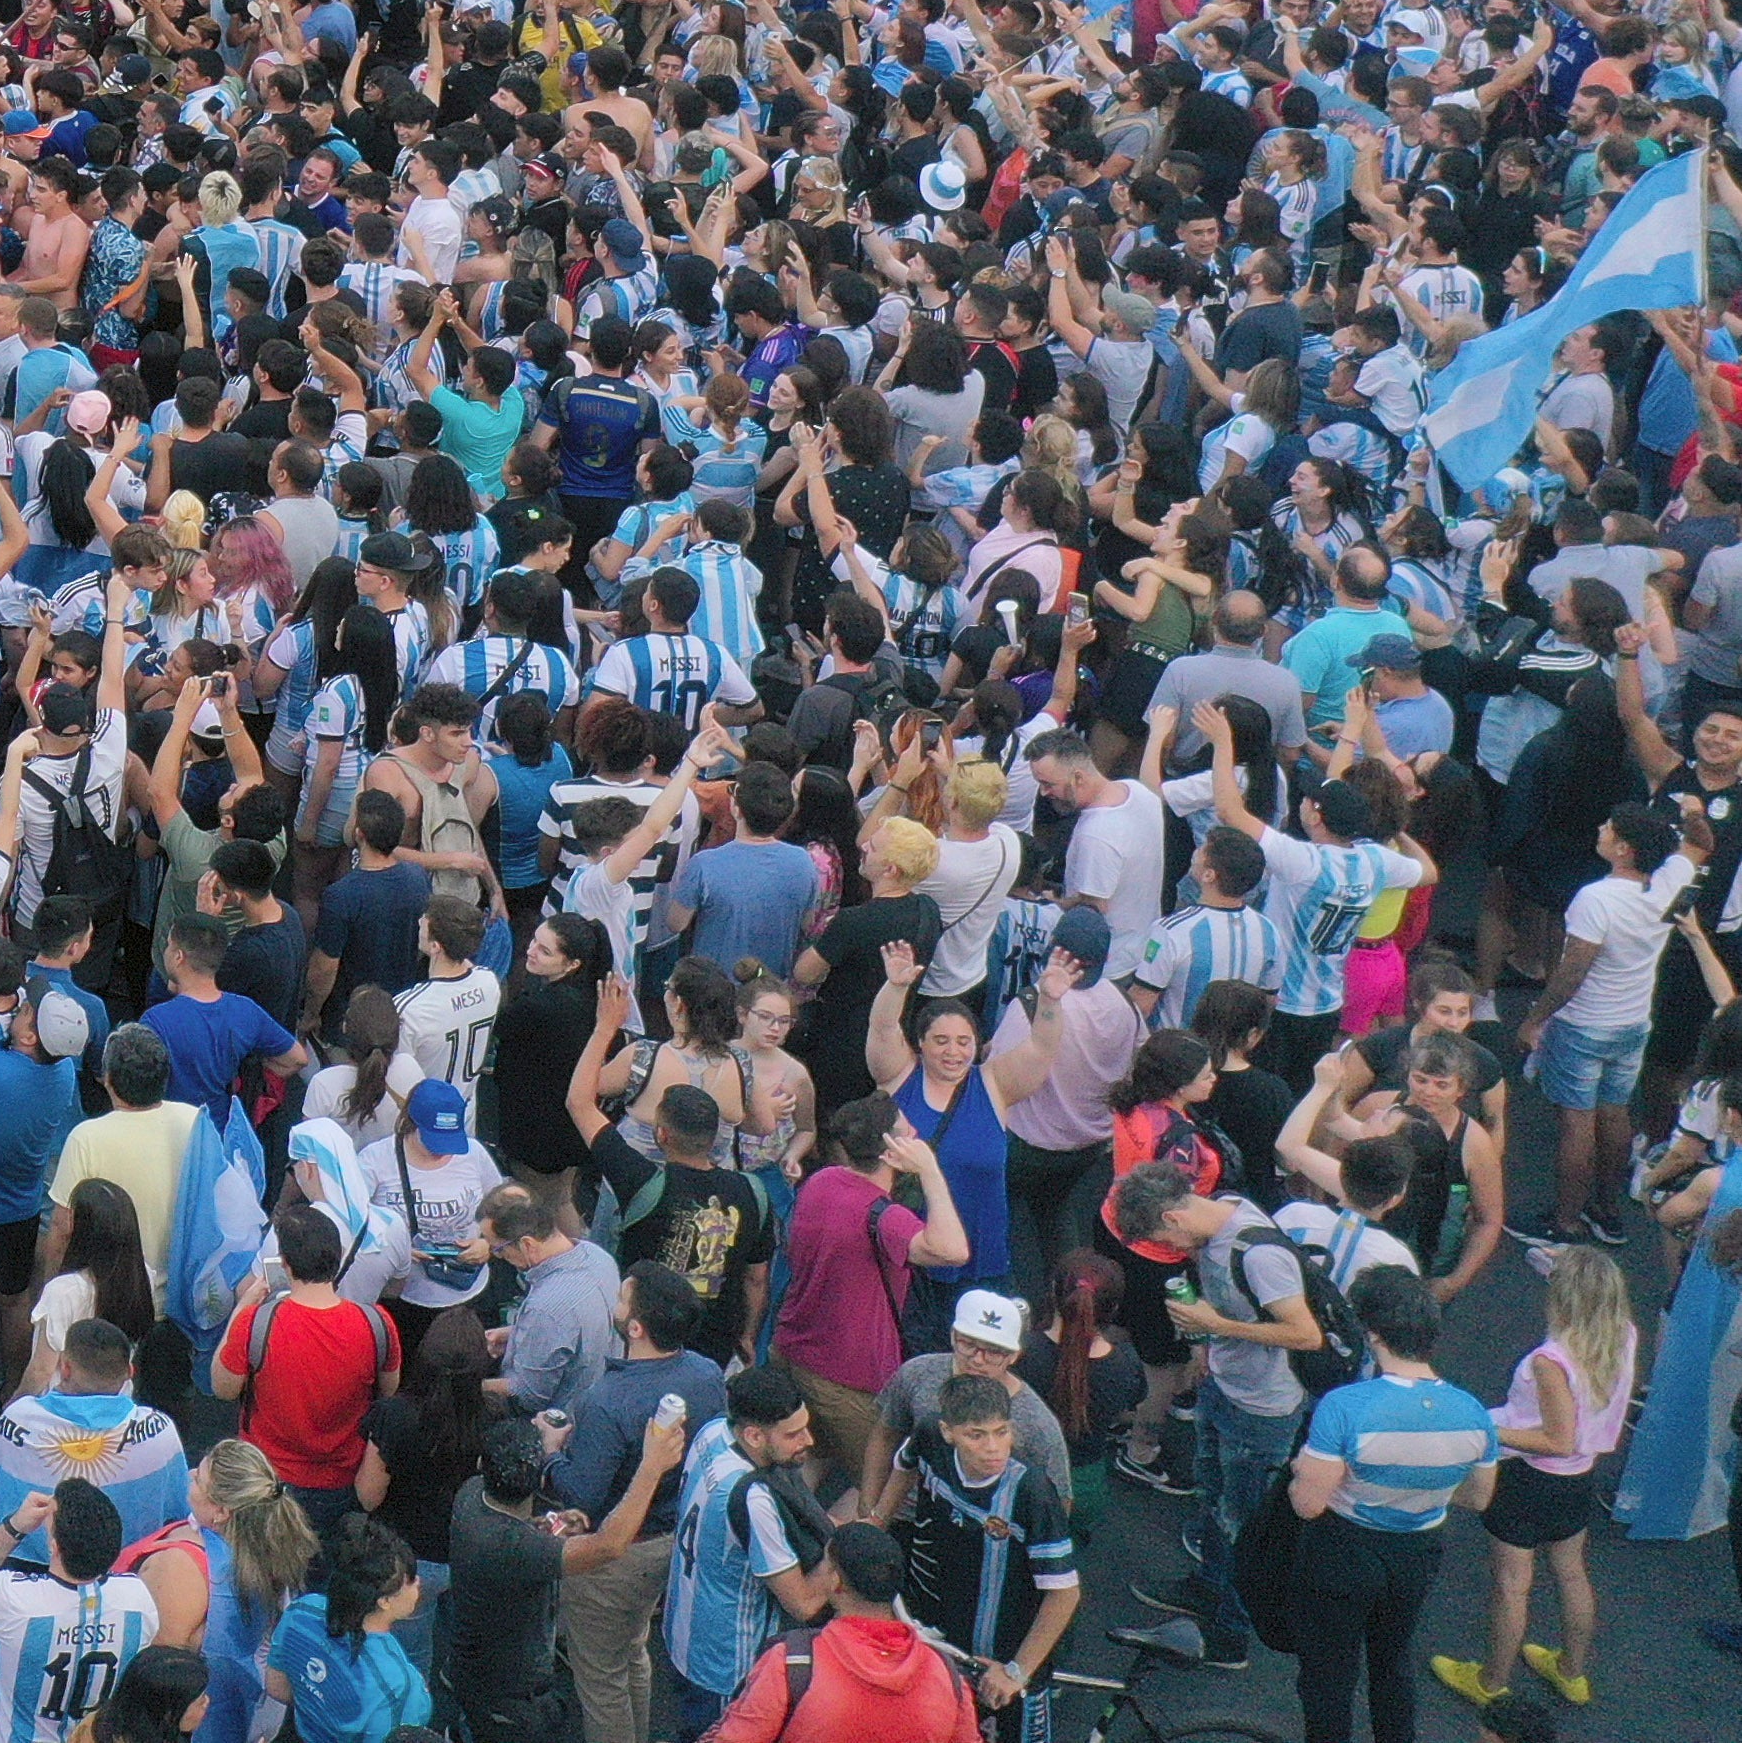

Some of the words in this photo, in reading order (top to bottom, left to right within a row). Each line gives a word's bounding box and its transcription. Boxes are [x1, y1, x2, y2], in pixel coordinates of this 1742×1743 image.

[659, 657, 701, 674] MESSI
[449, 988, 485, 1012] MESSI
[443, 1017, 495, 1084] 10
[55, 1622, 117, 1648] MESSI
